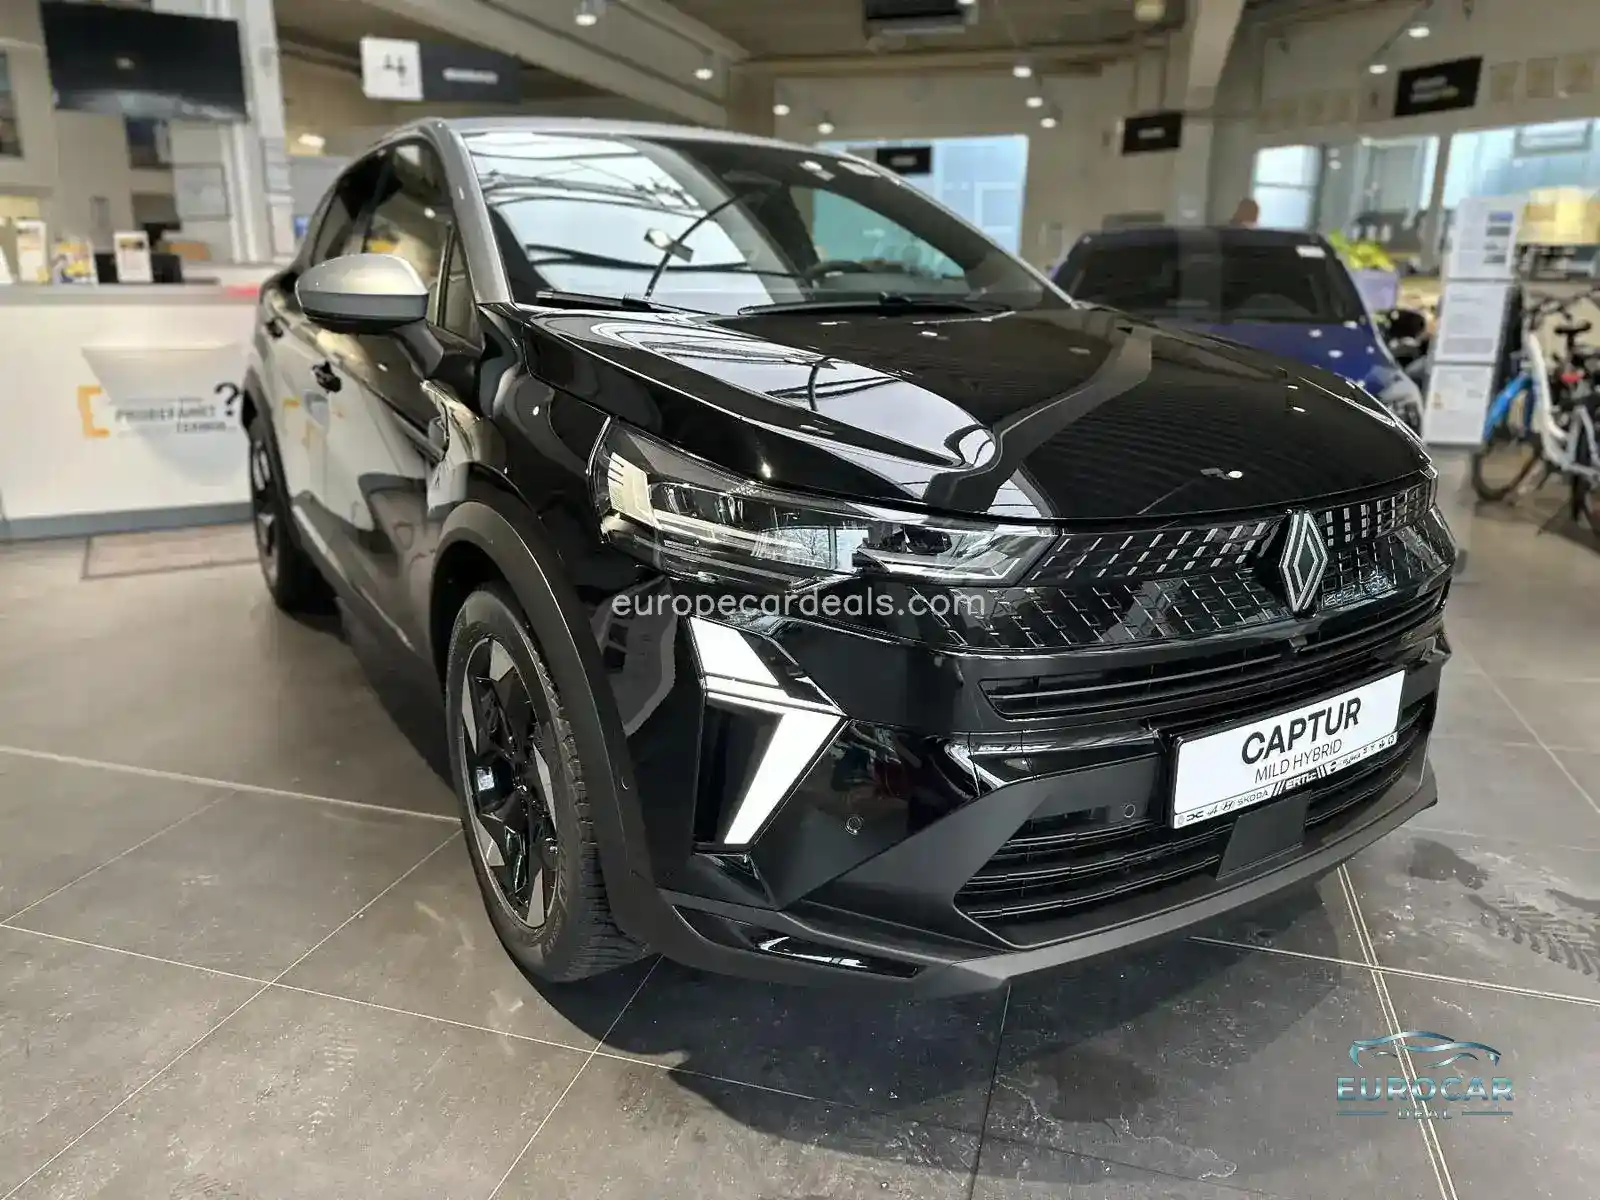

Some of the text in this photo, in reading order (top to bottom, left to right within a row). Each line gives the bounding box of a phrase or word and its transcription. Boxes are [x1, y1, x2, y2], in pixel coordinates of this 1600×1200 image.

[1241, 697, 1362, 765] CAPTUR
[1255, 755, 1290, 784] MILD
[1293, 738, 1343, 770] HYBRID
